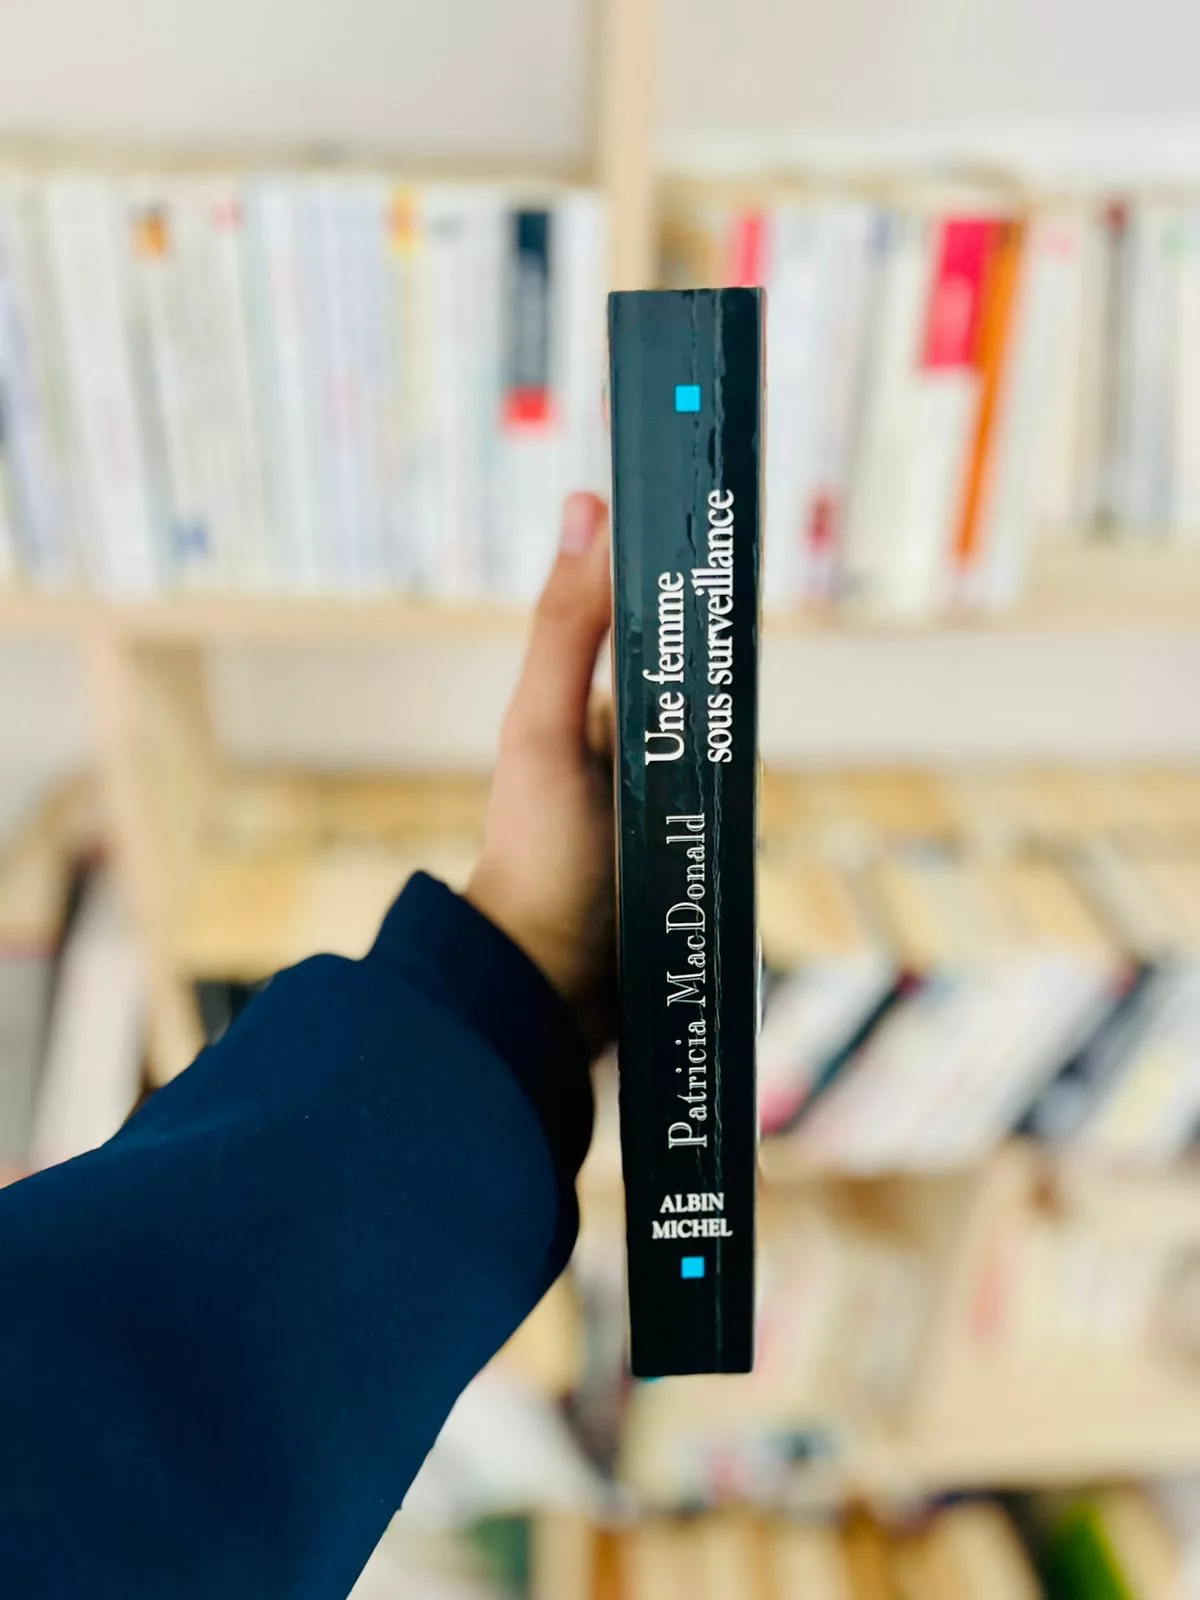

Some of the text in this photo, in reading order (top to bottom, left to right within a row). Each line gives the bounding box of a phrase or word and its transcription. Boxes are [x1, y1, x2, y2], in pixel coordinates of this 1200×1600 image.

[642, 571, 685, 766] Une femme
[691, 488, 734, 763] sous surveillance
[666, 812, 708, 1149] Patricia MacDonald
[651, 1217, 733, 1240] MICHEL
[659, 1192, 725, 1214] ALBIN
